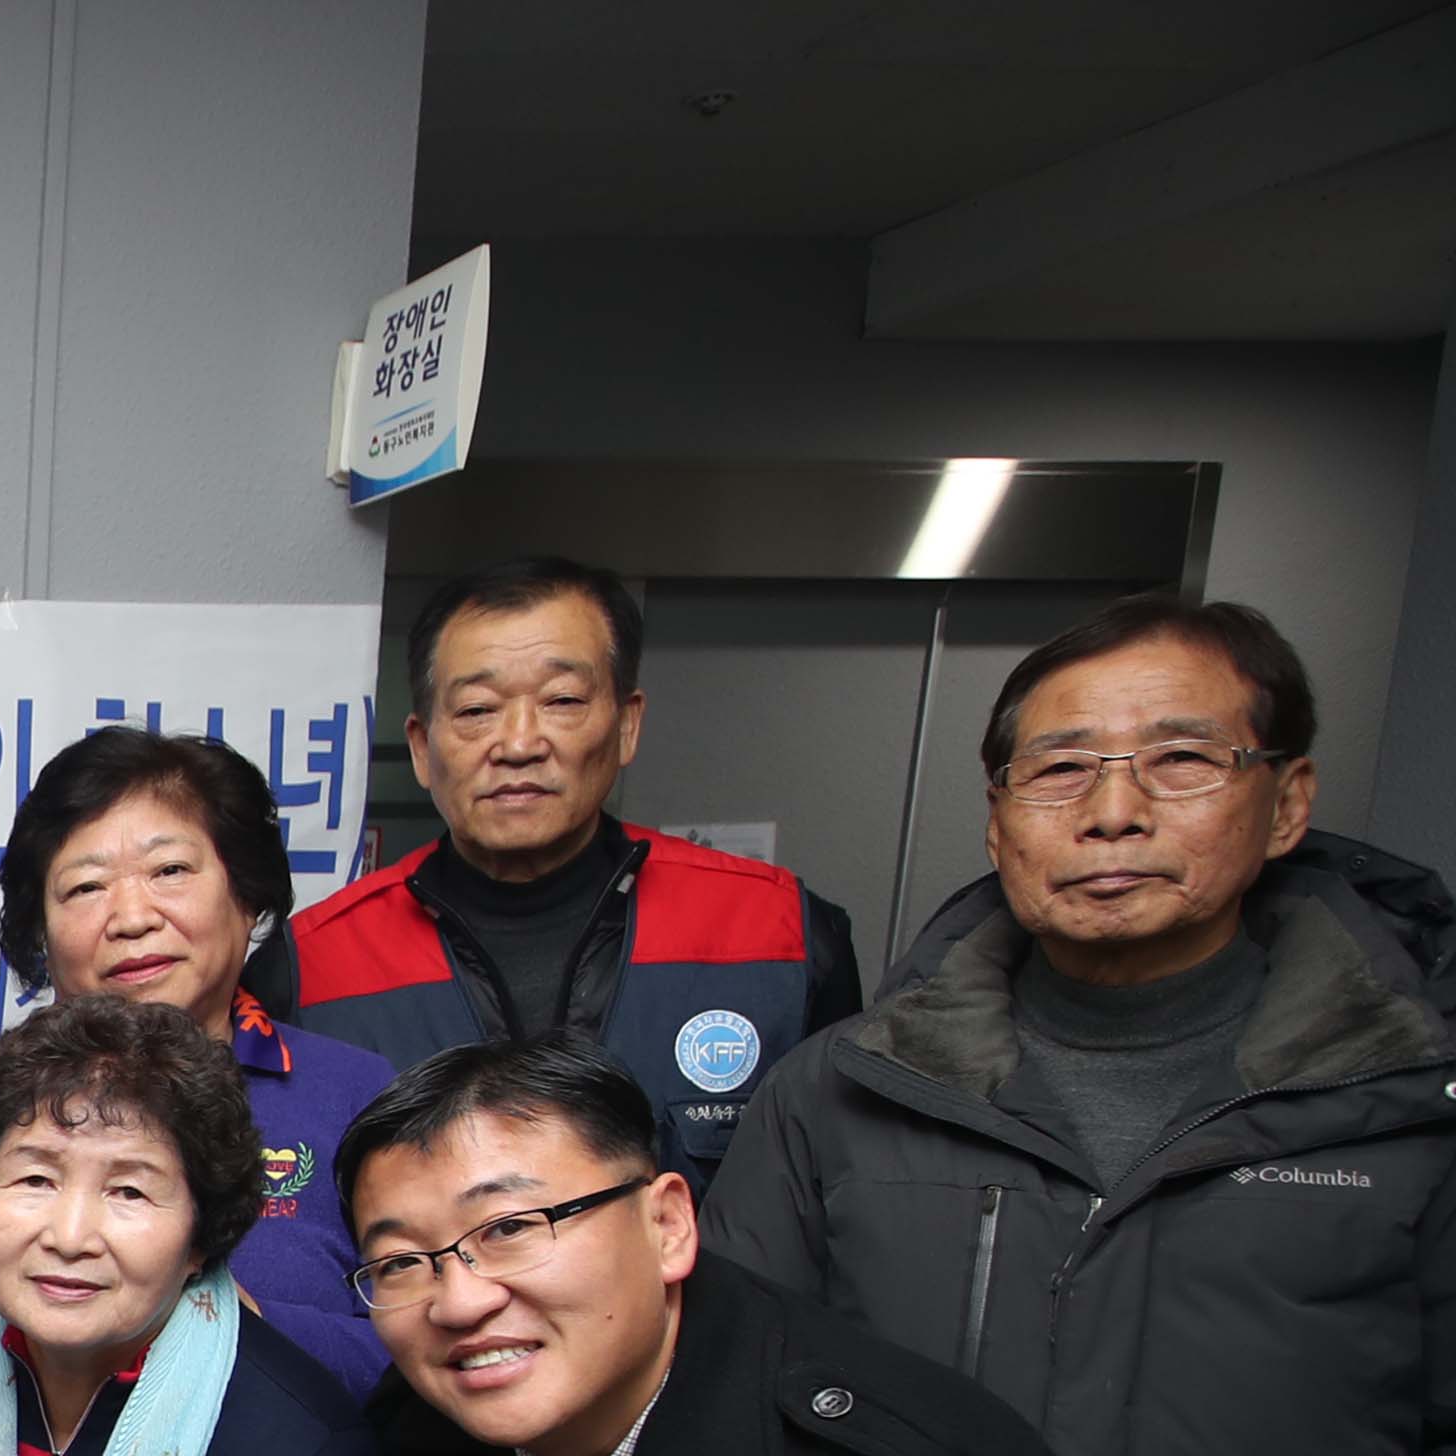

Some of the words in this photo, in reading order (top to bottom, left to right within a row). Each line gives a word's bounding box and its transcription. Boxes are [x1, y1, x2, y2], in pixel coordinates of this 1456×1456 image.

[383, 284, 453, 354] 장애인
[373, 334, 443, 398] 화장실
[694, 1041, 747, 1064] KFF
[1259, 1167, 1371, 1188] Columbia
